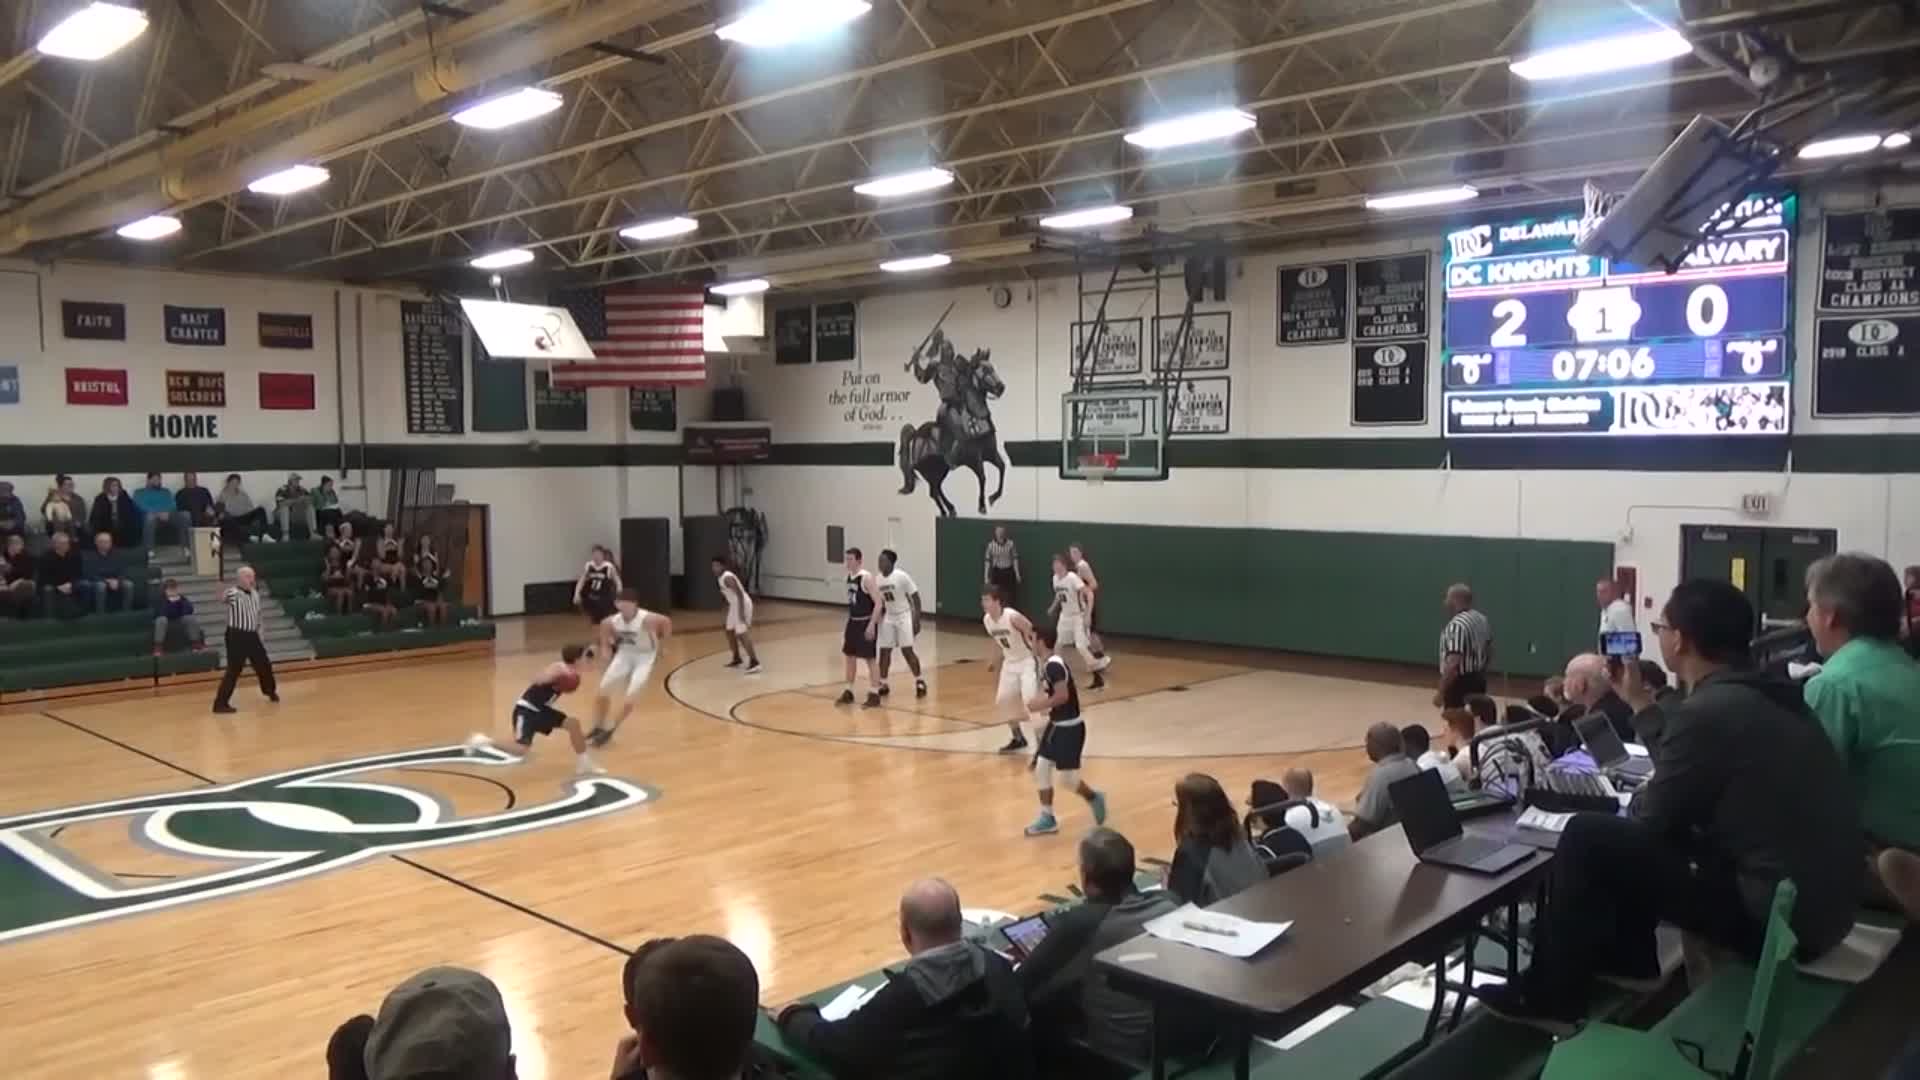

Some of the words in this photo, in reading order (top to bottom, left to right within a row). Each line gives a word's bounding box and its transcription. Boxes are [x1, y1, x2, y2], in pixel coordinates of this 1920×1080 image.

[1451, 264, 1483, 286] DC
[1487, 255, 1590, 282] KNIGHTS
[1830, 291, 1920, 306] CHAMPIONS
[1595, 307, 1613, 334] 1
[1686, 283, 1729, 337] 0
[1490, 299, 1527, 348] 2
[1552, 347, 1656, 381] 07:06
[73, 380, 121, 395] BRISTOL
[842, 370, 863, 386] Put
[865, 374, 881, 385] on
[828, 390, 847, 406] the
[848, 388, 871, 404] full
[872, 390, 911, 403] armor
[843, 406, 857, 422] of
[149, 414, 218, 438] HOME
[1743, 495, 1767, 509] EXIT
